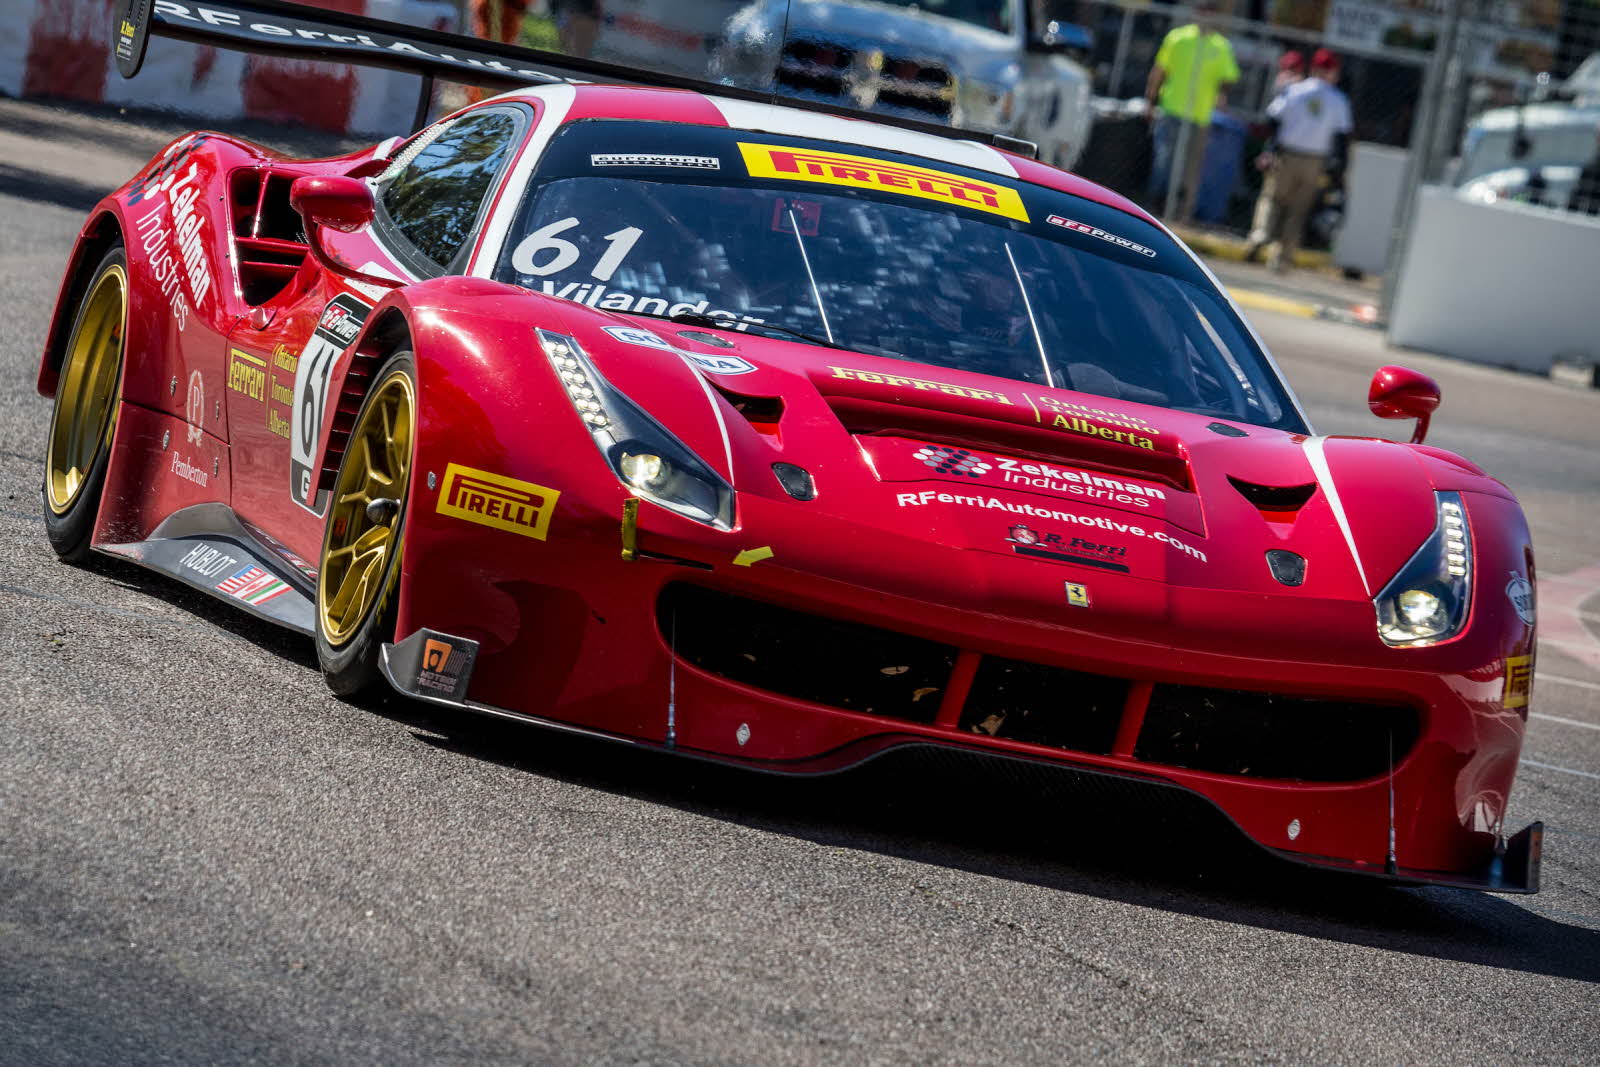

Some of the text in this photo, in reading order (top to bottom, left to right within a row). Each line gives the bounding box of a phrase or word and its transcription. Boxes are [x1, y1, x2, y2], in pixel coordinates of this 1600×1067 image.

[599, 155, 713, 164] euroworld
[768, 150, 1000, 208] PIRELLI
[169, 162, 211, 309] Zekelman
[511, 216, 643, 281] 61
[136, 201, 188, 331] Industries
[542, 280, 765, 332] Vilander
[228, 348, 267, 402] Ferrari
[827, 365, 1014, 406] Ferrari
[302, 343, 334, 458] 61
[1040, 396, 1147, 424] Ontario
[1045, 404, 1160, 434] Toronto
[1052, 414, 1155, 451] Alberta
[171, 451, 209, 488] Pemberton
[995, 457, 1166, 500] Zekelman
[1004, 471, 1150, 507] Industries
[447, 473, 545, 528] PIRELLI
[896, 490, 1208, 562] RFerriAutomotive.com
[179, 542, 238, 578] HUBLOT
